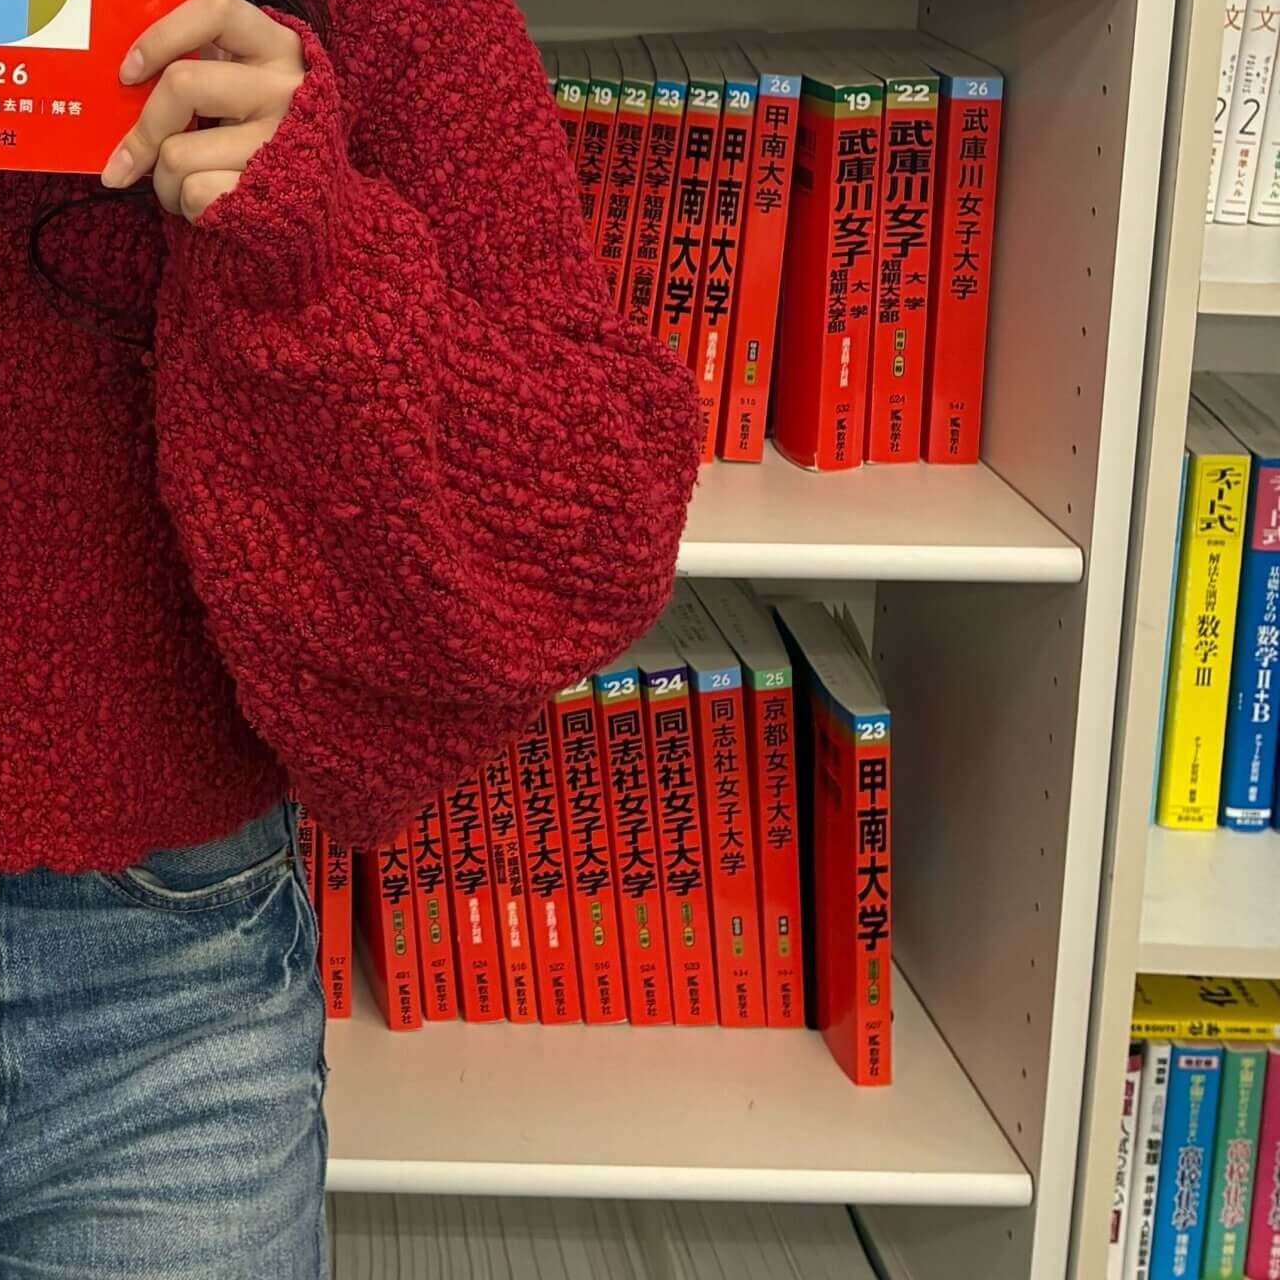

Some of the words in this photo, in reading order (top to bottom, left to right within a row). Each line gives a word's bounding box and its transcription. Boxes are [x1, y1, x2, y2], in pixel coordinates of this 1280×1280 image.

[52, 99, 83, 116] 解答
[691, 88, 719, 108] '22
[844, 90, 871, 111] '19
[1239, 99, 1260, 135] 2
[753, 104, 790, 214] 甲南大学
[883, 120, 933, 260] 武庫川女子
[663, 125, 712, 324] 甲南大学
[703, 127, 745, 326] 甲南大学
[831, 127, 878, 269] 武庫川女子
[950, 107, 989, 301] 武庫川女子大学
[827, 269, 849, 334] 短期大学部
[849, 279, 870, 320] 大学
[879, 259, 902, 324] 短期大学部
[904, 271, 928, 312] 大学
[1200, 467, 1241, 532] チャート式
[603, 678, 635, 698] '23
[857, 722, 886, 740] '23
[655, 709, 703, 897] 同志社女子大学
[711, 698, 747, 876] 同志社女子大学
[763, 697, 793, 849] 京都女子大学
[857, 759, 889, 951] 甲南大学
